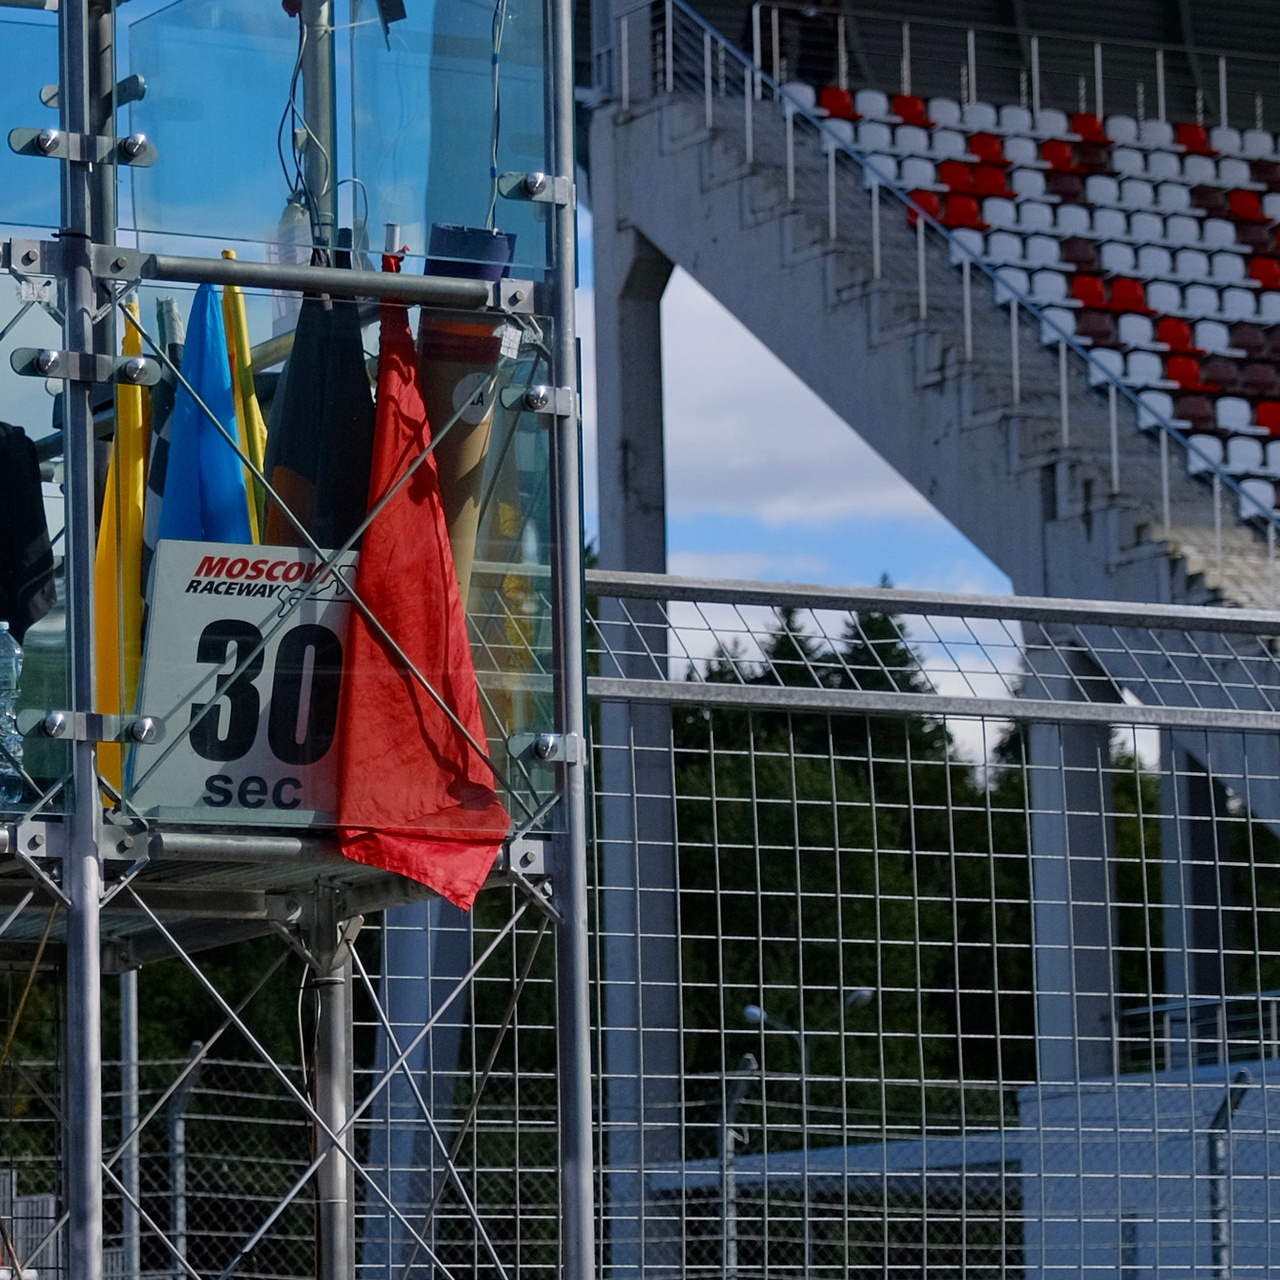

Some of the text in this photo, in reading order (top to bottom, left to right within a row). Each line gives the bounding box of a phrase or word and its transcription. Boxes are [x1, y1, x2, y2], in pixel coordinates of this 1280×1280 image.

[194, 555, 338, 585] MOSCOW
[185, 579, 282, 599] RACEWAY
[189, 619, 344, 766] 30
[202, 773, 303, 811] sec
